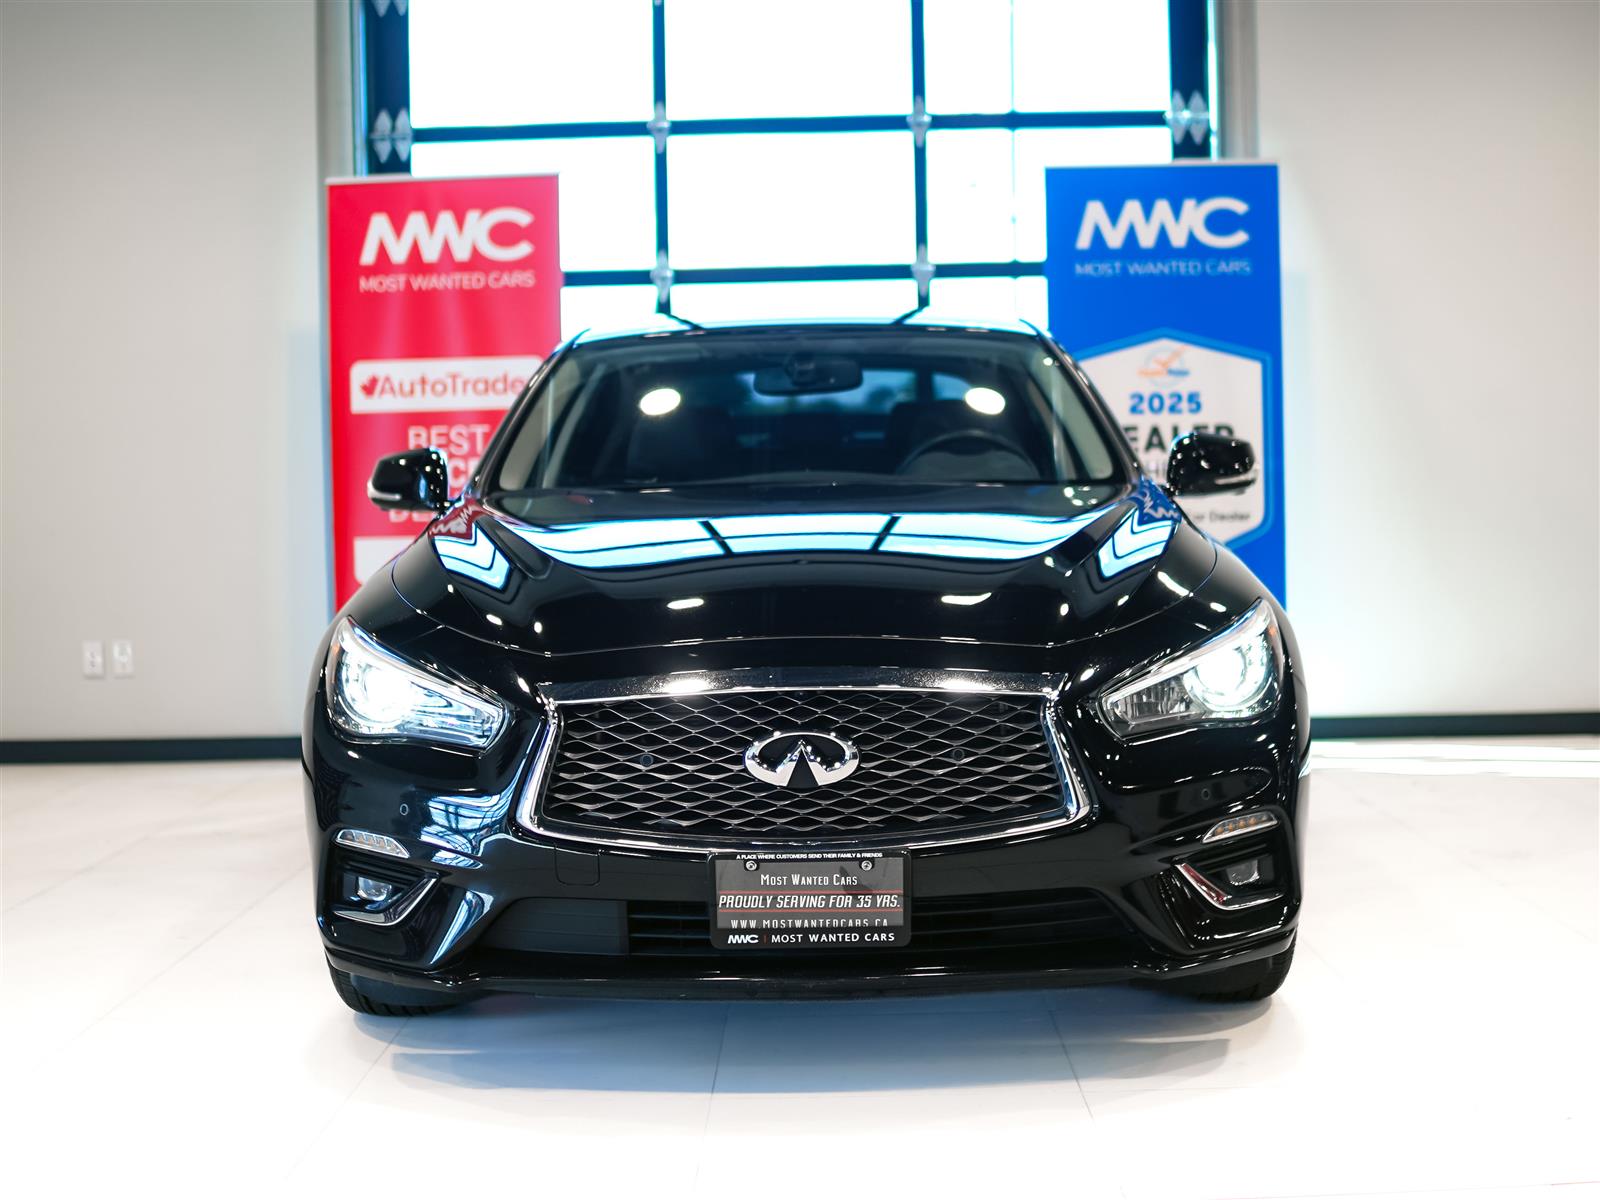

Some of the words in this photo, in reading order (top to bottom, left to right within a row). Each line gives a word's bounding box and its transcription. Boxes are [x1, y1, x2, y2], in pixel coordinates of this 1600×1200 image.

[1075, 196, 1250, 250] MWC
[358, 206, 535, 266] MWC
[1075, 260, 1121, 277] MOST
[1127, 259, 1201, 276] WANTED
[1206, 257, 1251, 275] CARS
[358, 274, 407, 293] MOST
[409, 272, 486, 291] WANTED
[488, 270, 535, 288] CARS
[379, 372, 525, 399] AutoTrade
[1128, 391, 1202, 415] 2025
[408, 424, 490, 456] BEST
[719, 895, 772, 908] PROUDLY
[776, 895, 826, 908] SERVING
[829, 895, 851, 908] FOR
[856, 895, 872, 908] 35
[876, 895, 901, 908] YRS.
[730, 918, 889, 929] WWW.MOSTWANTEDCARSCA
[727, 934, 759, 944] MWC
[771, 934, 803, 943] MOST
[808, 933, 860, 943] WANTED
[864, 932, 895, 942] CARS
